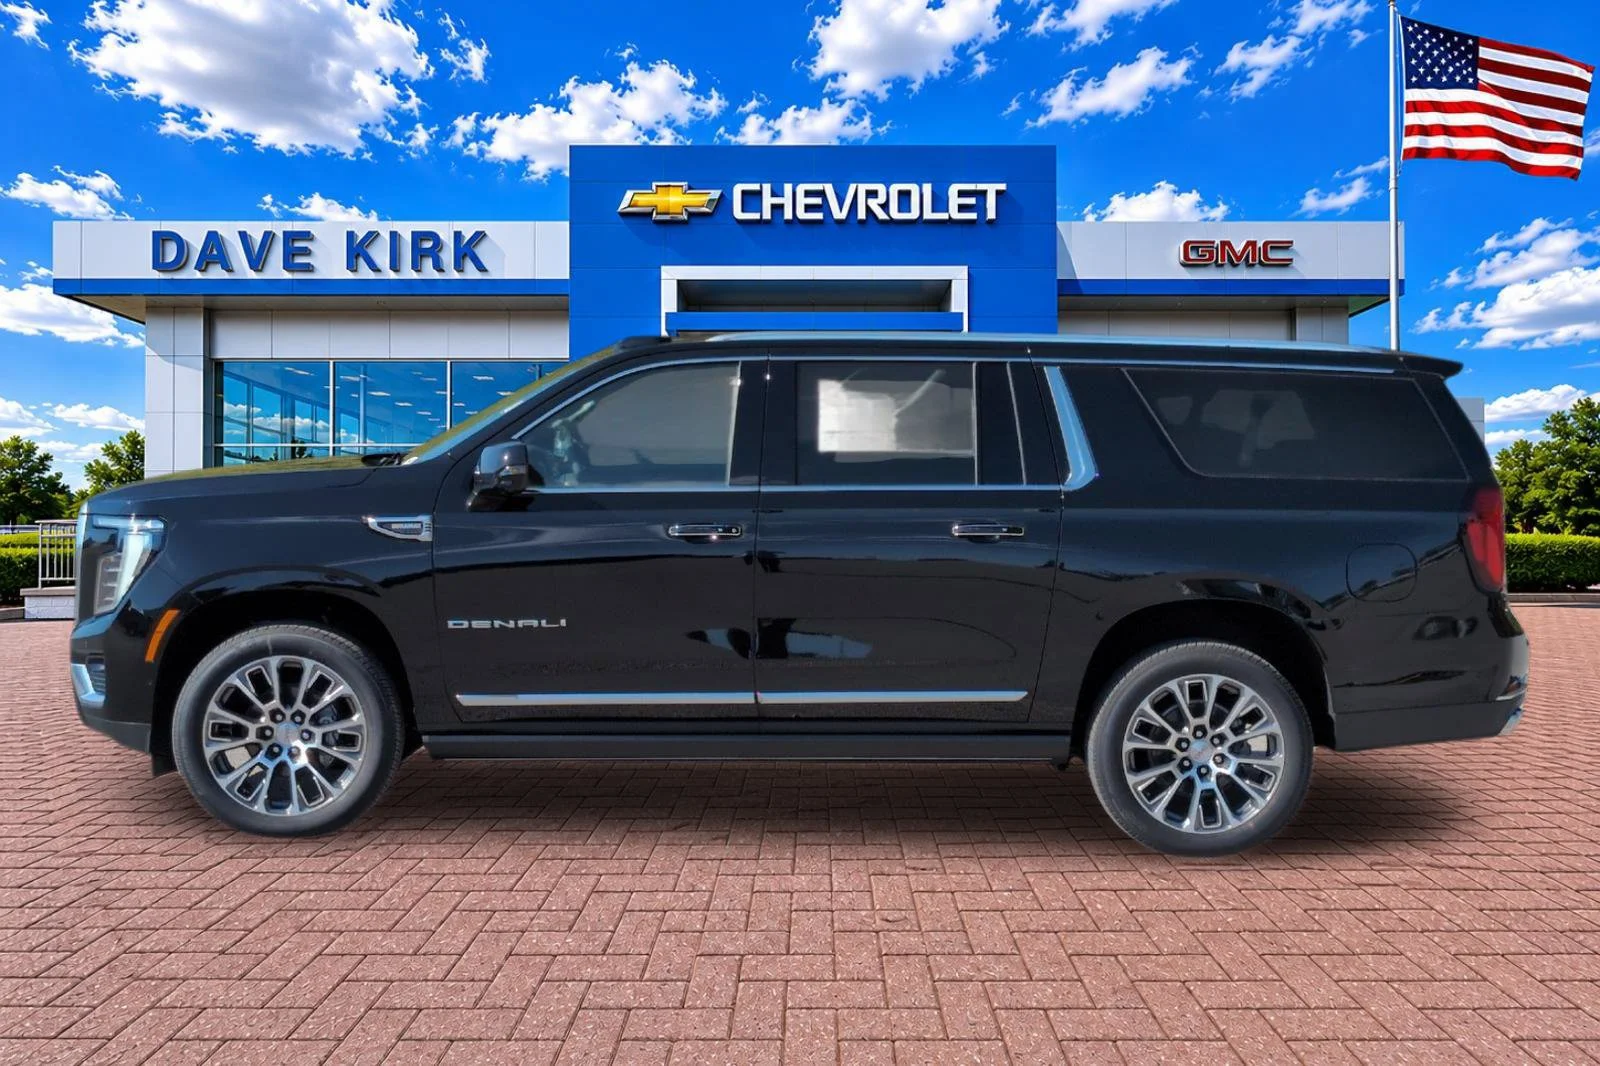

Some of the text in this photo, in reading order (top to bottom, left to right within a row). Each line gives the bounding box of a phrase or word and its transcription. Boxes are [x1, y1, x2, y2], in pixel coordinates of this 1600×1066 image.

[732, 183, 1007, 221] CHEVROLET
[152, 230, 489, 272] DAVE KIRK
[1180, 240, 1294, 266] GMC
[447, 618, 567, 629] DENALI
